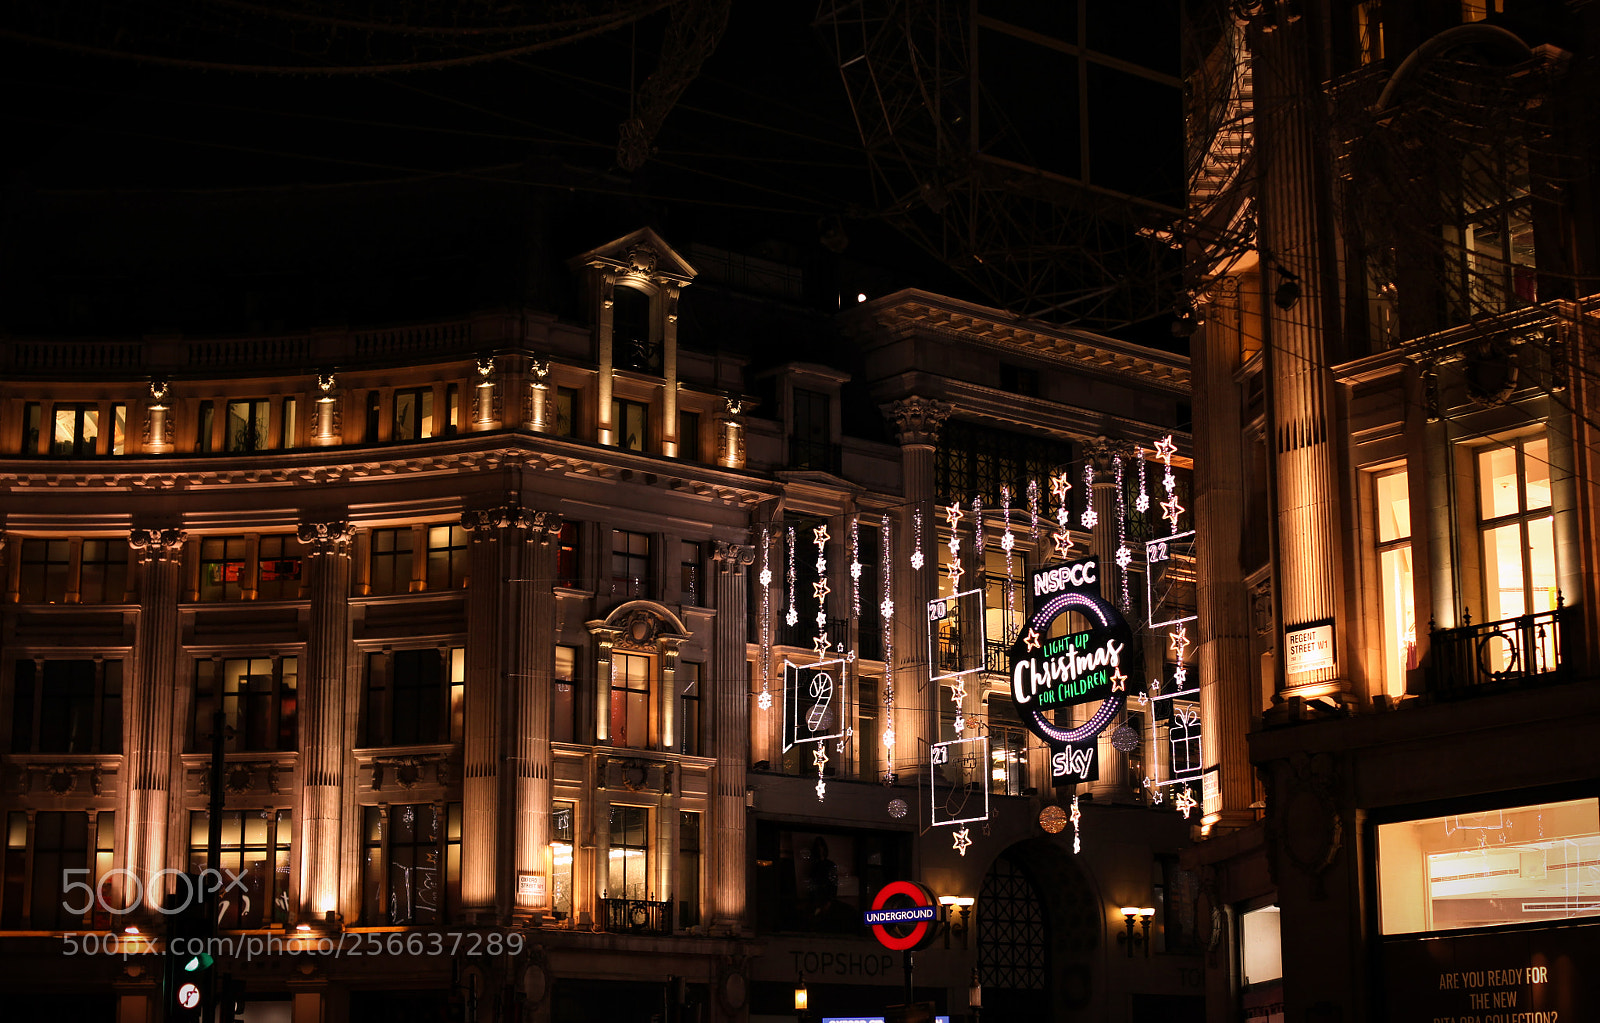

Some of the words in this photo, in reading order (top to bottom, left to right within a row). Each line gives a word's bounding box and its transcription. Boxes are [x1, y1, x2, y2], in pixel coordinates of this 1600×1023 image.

[1149, 543, 1169, 562] 22
[1034, 561, 1096, 596] NSPCC
[929, 601, 946, 620] 20
[1043, 636, 1071, 657] LIGHT
[1075, 633, 1089, 650] UP
[1290, 631, 1316, 644] REGENT
[1290, 642, 1315, 655] STREET
[1317, 640, 1328, 650] W1
[1013, 639, 1124, 704] Christmas
[1039, 690, 1055, 706] FOR
[1058, 669, 1107, 702] CHILDREN
[932, 746, 948, 765] 21
[1052, 744, 1094, 780] sky
[866, 909, 934, 922] UNDERGROUND
[790, 951, 893, 977] TOPSHOP
[1440, 972, 1460, 991] ARE
[1462, 970, 1485, 989] YOU
[1487, 968, 1523, 987] READY
[1526, 967, 1547, 984] FOR
[1469, 993, 1491, 1010] THE
[1493, 990, 1518, 1009] NEW
